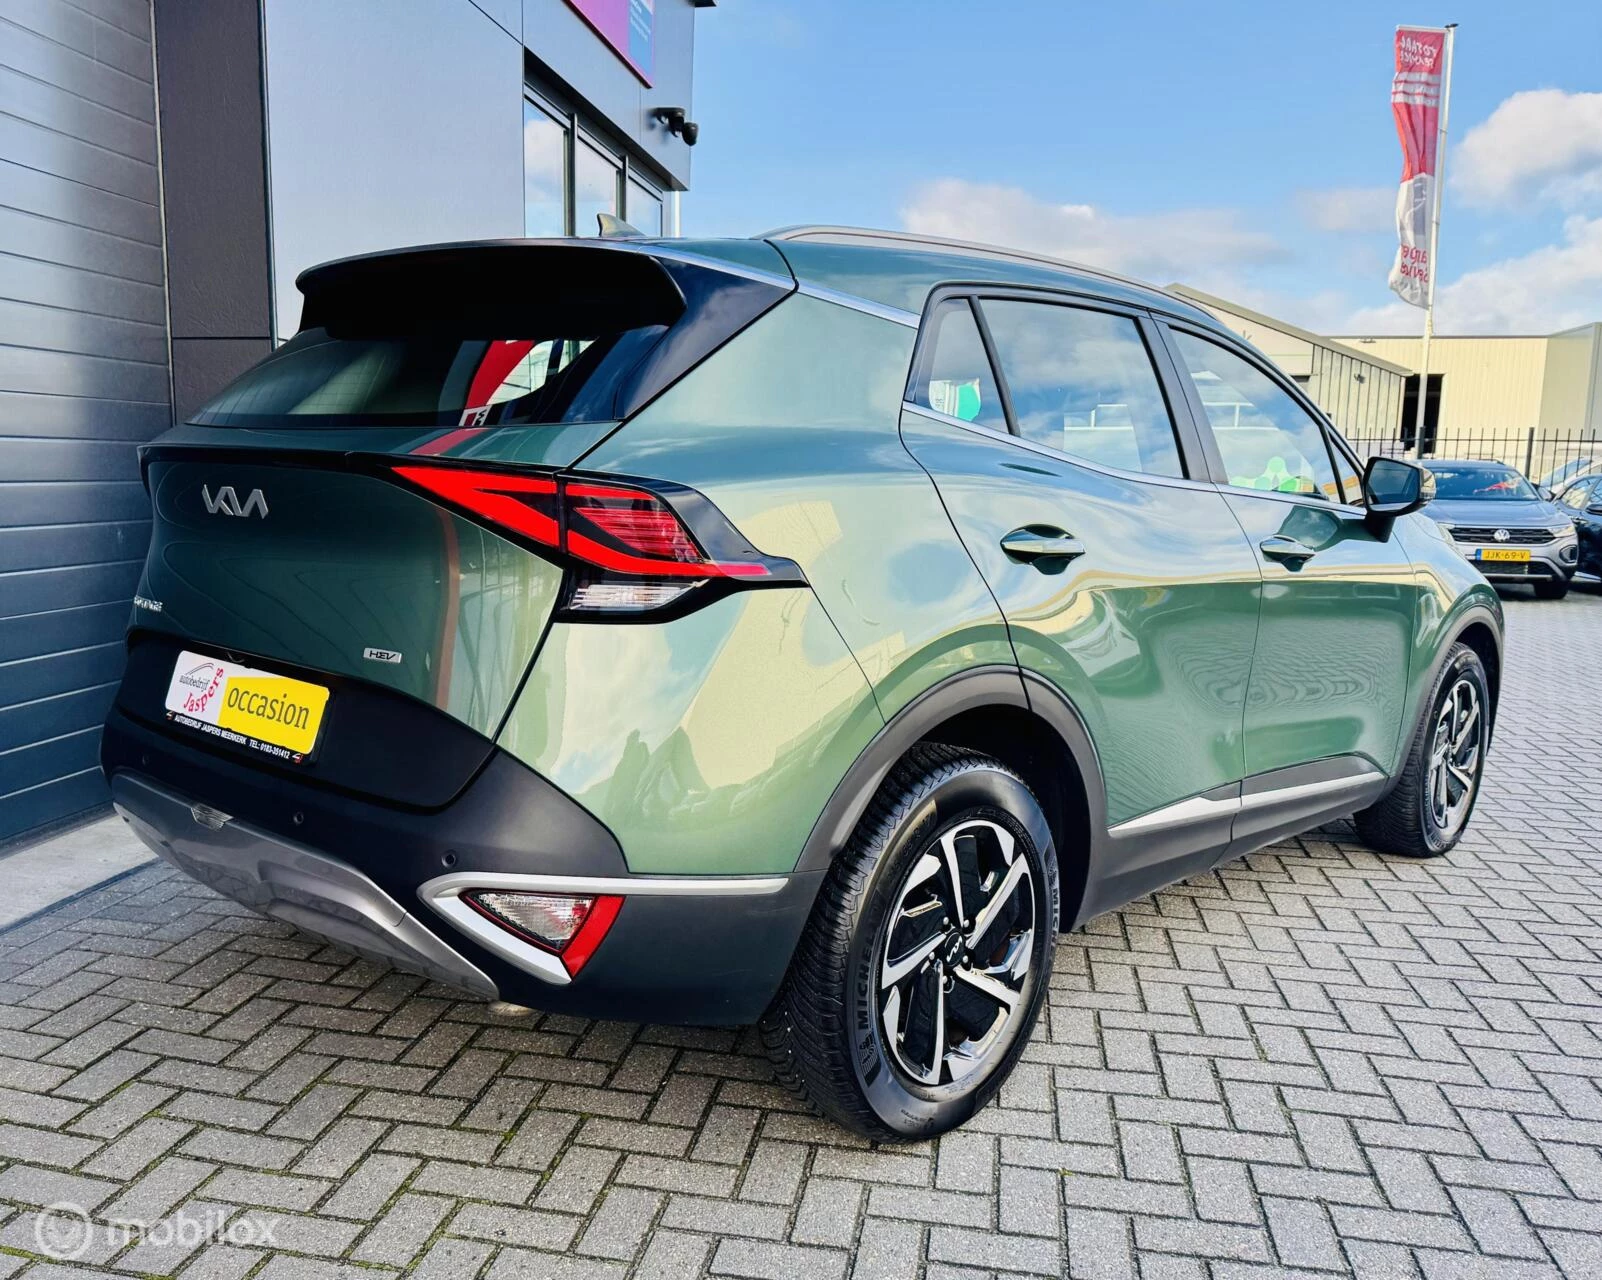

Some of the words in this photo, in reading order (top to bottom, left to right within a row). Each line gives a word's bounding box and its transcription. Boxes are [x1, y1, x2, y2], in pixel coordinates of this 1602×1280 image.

[202, 484, 269, 519] KIA
[369, 650, 396, 660] HEV
[183, 667, 224, 713] Jaspers
[174, 714, 203, 729] AUTOBEDRIJF
[201, 723, 221, 736] JASPERS
[227, 687, 310, 730] occasion
